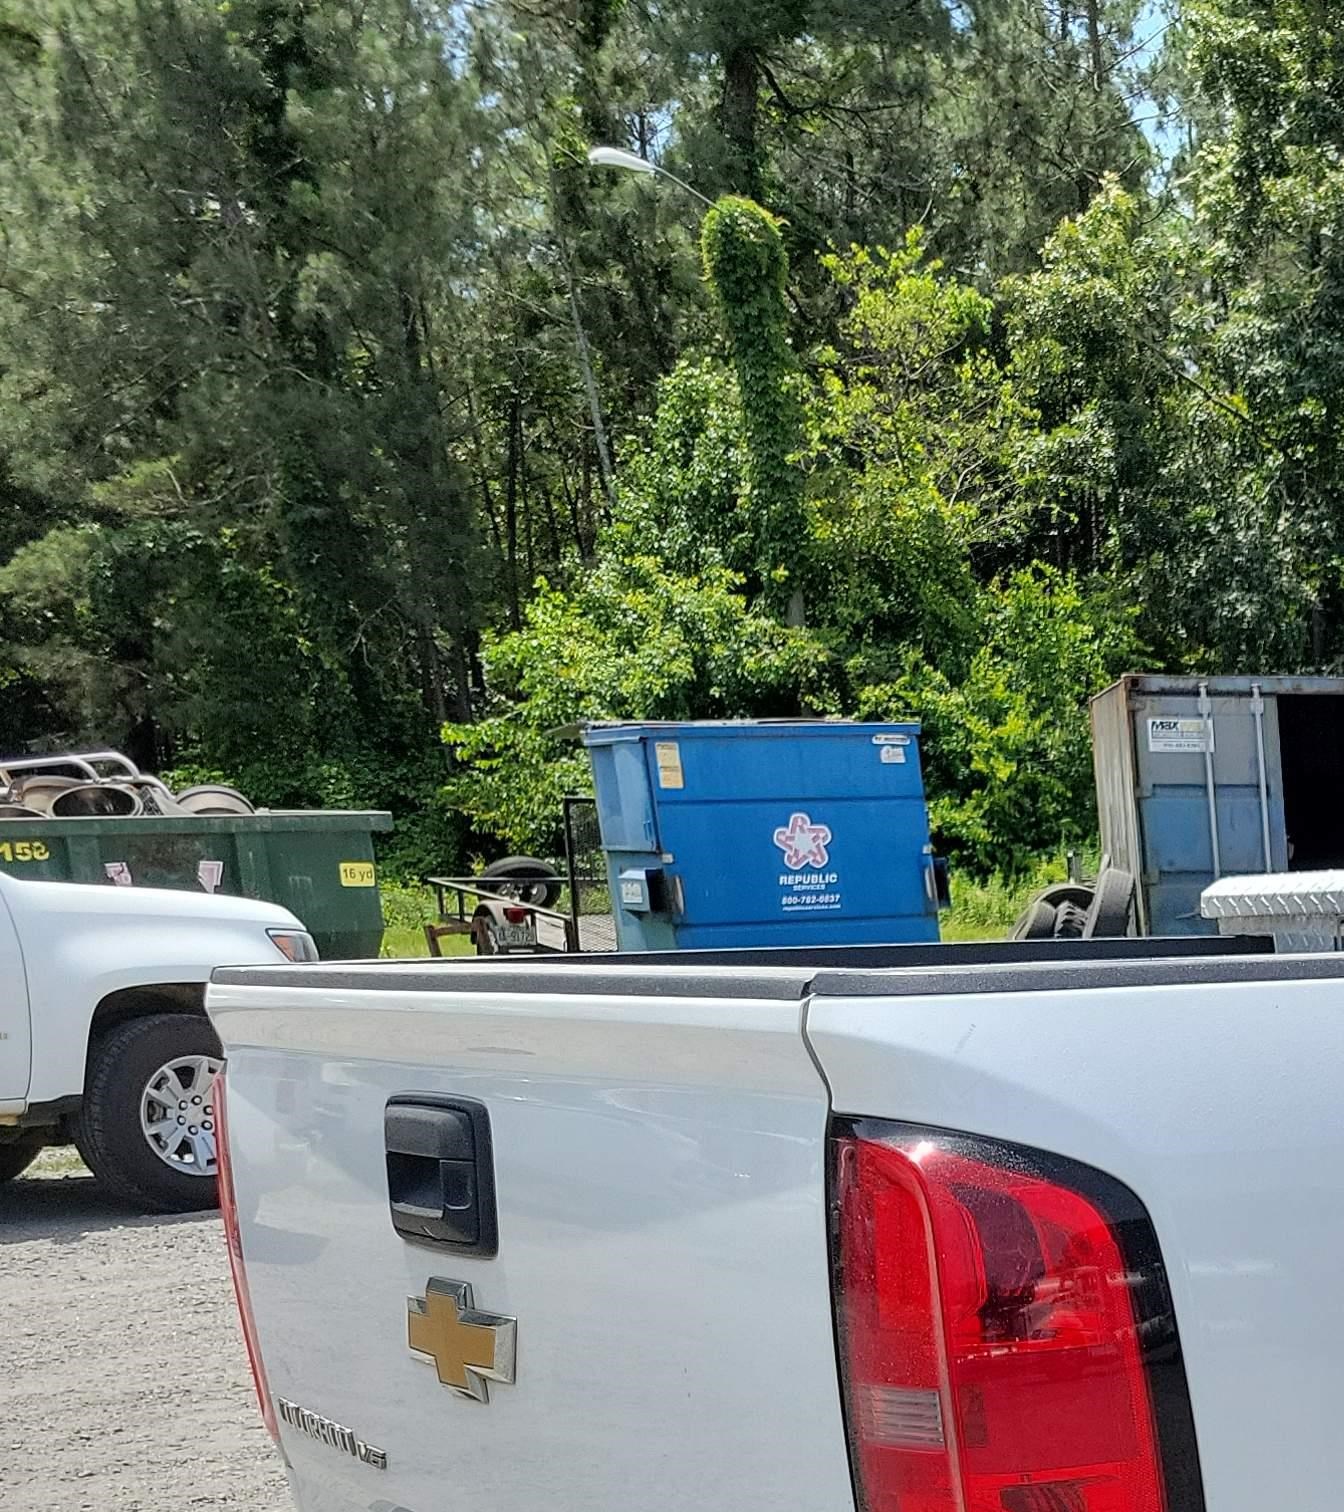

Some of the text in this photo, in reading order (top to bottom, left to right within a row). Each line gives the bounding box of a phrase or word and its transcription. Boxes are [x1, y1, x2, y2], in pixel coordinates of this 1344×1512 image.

[343, 868, 373, 882] 16 yd
[779, 873, 838, 886] REPUBLIC
[357, 1440, 387, 1470] V6
